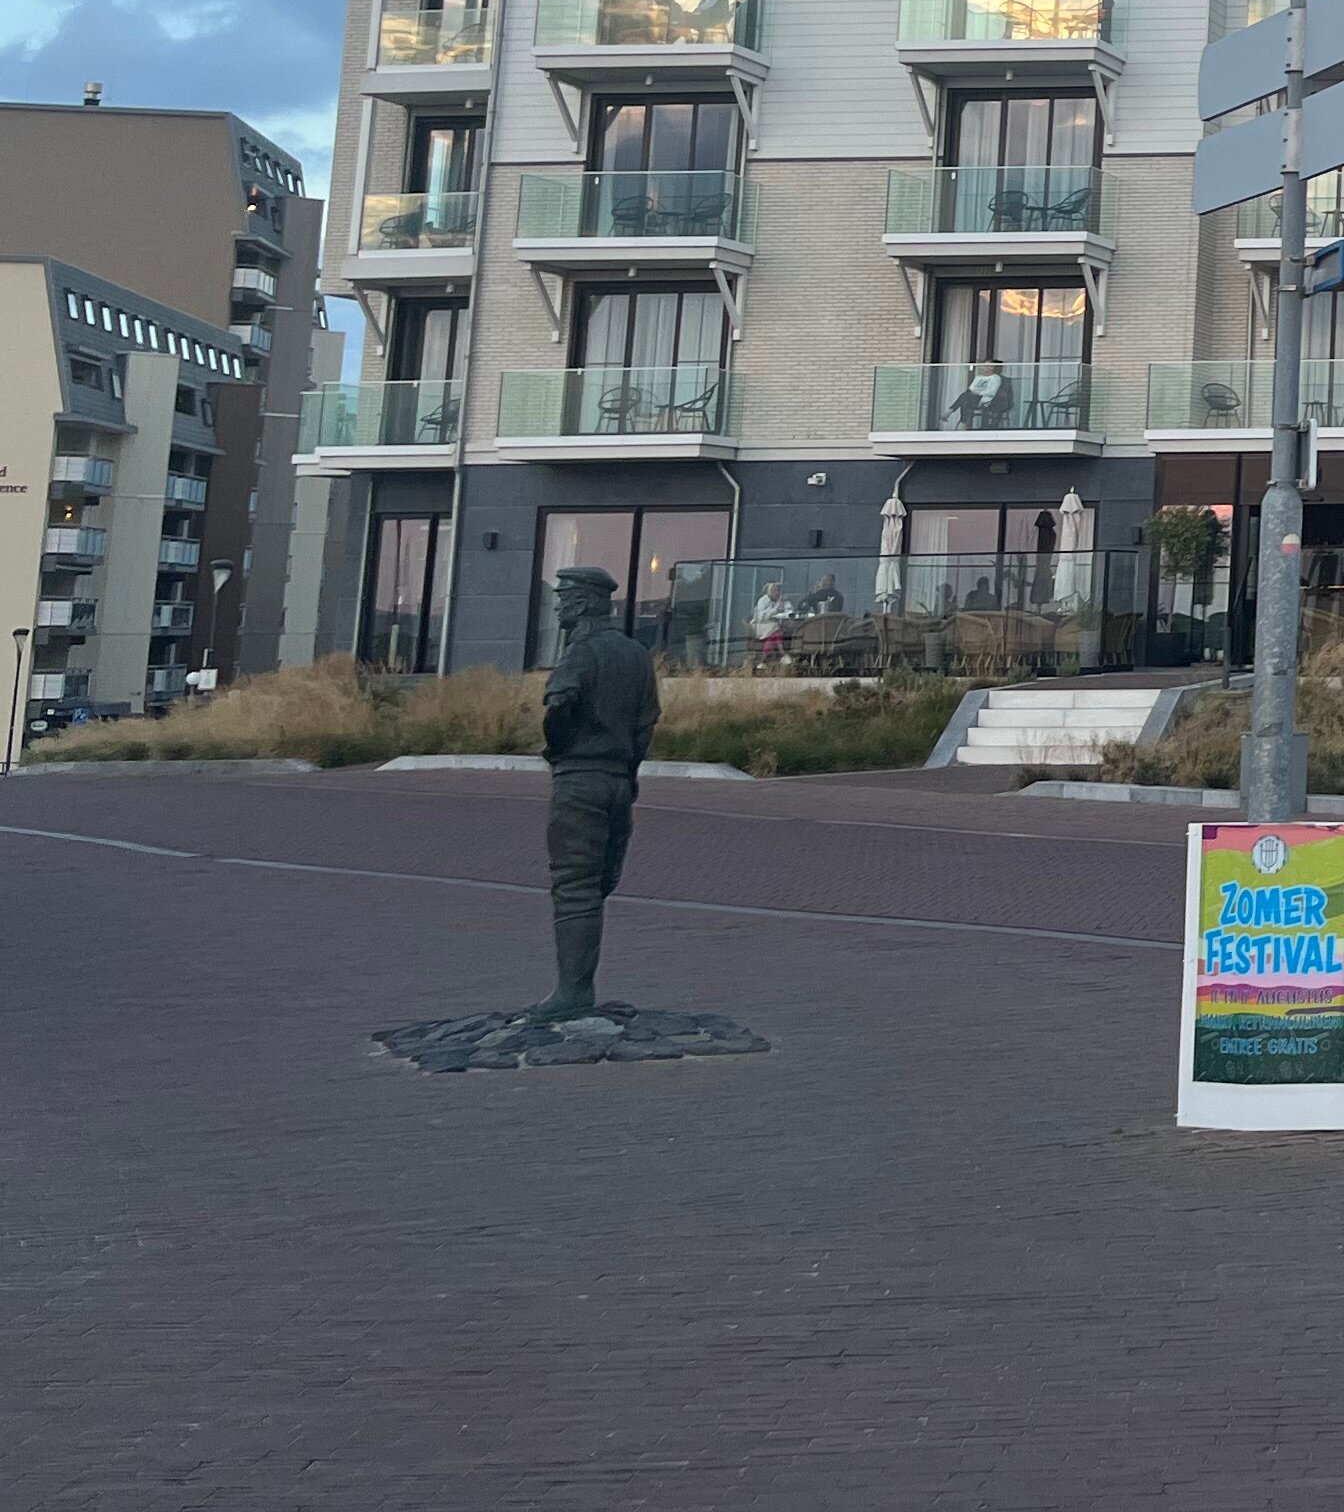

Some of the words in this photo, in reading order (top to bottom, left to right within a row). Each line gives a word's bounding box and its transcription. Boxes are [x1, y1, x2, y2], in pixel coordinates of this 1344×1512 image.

[1219, 881, 1327, 927] ZOMER
[1204, 929, 1344, 975] FESTIVAL
[1267, 1037, 1318, 1055] GRATIS
